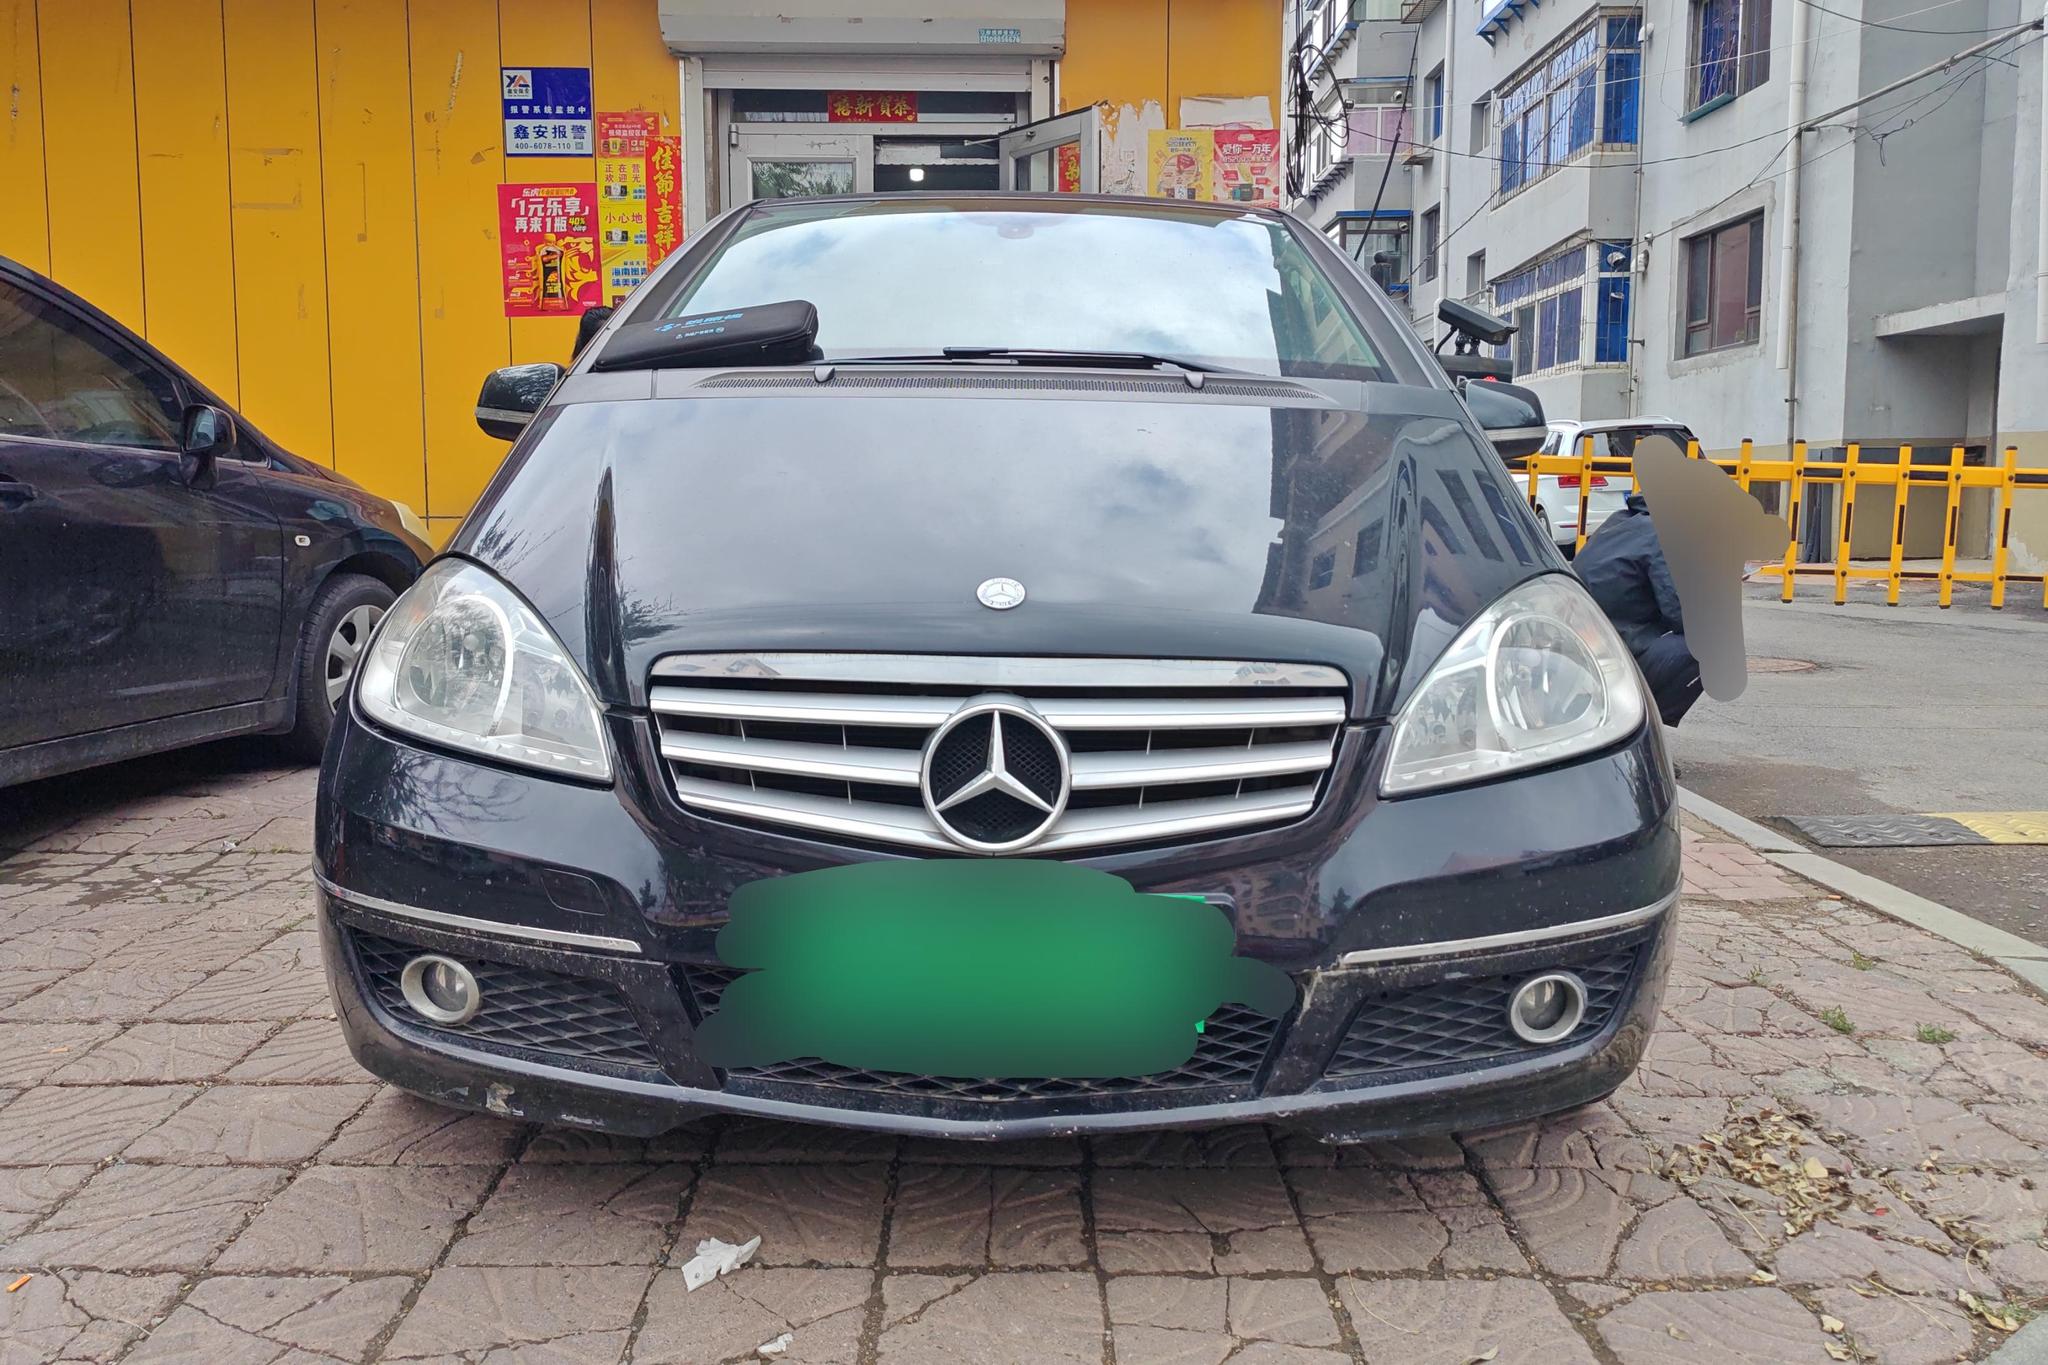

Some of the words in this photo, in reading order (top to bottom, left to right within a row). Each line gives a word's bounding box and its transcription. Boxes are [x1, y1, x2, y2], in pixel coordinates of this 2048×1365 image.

[510, 105, 587, 115] 报警系统监控中
[513, 124, 587, 140] 鑫安报警
[515, 142, 572, 150] 400-6078-110
[605, 212, 646, 224] 小心地
[515, 216, 568, 233] 再来1瓶
